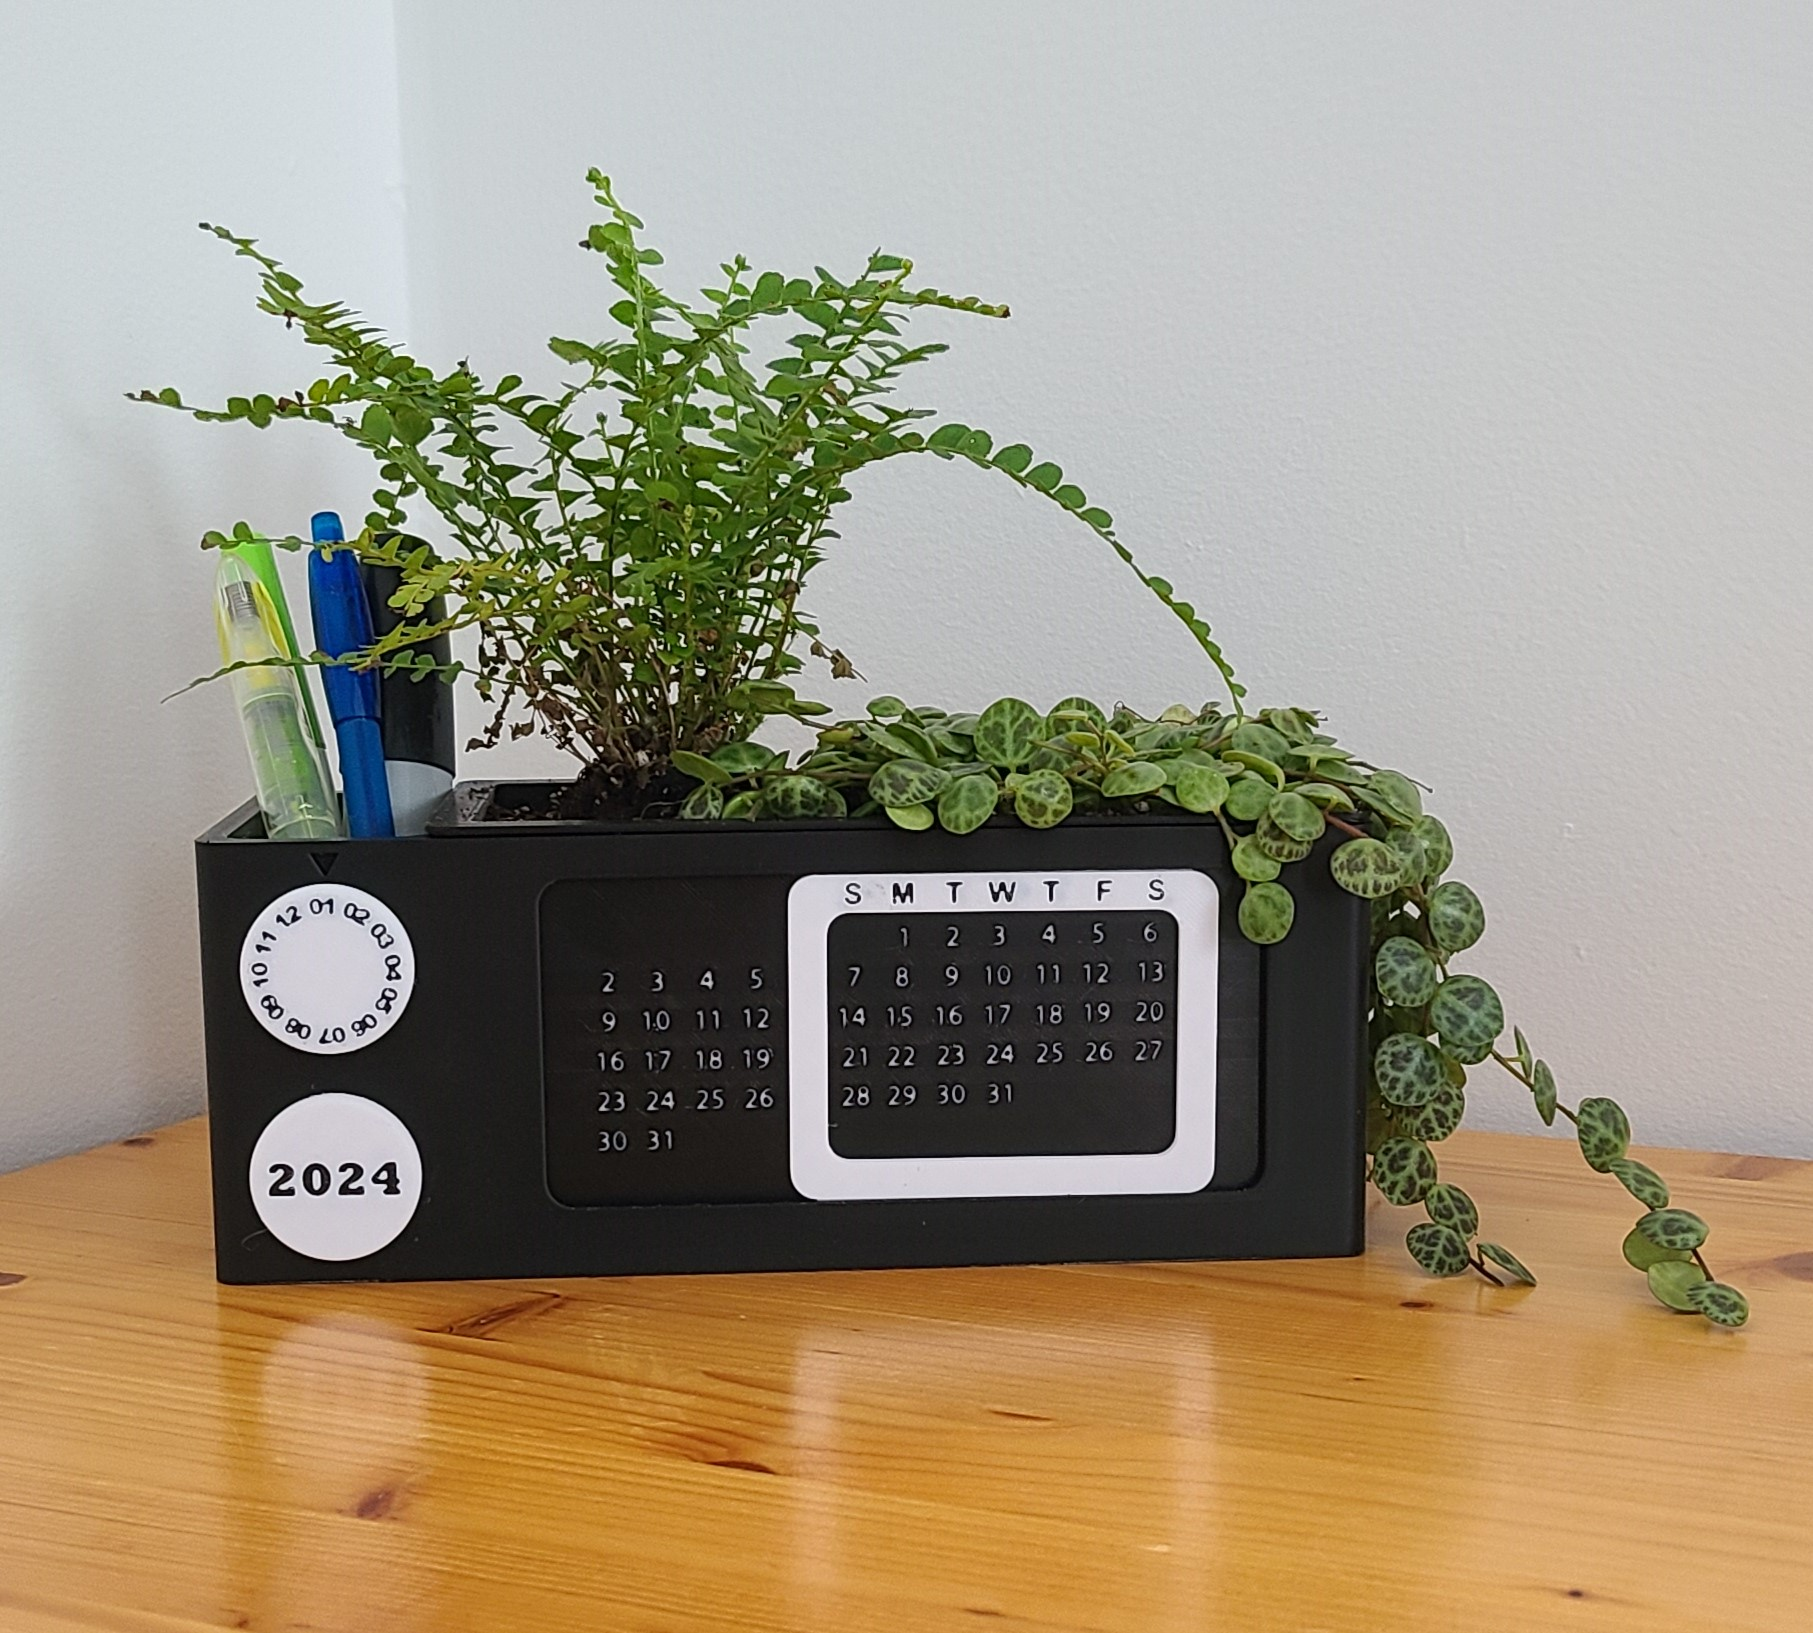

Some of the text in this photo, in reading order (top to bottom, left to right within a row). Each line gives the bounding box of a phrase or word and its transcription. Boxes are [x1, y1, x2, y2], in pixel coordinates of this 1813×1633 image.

[844, 878, 1165, 905] S M T W T F S
[900, 922, 1157, 947] 1 2 3 4 5 6
[251, 898, 402, 1045] 01 02 03 04 05 06 07 08 09 10 11 12
[602, 961, 1167, 993] 2 3 4 5 7 8 9 10 11 12 13
[602, 1001, 1164, 1032] 9 10 11 12 14 15 16 17 18 19 20
[597, 1040, 1162, 1072] 16 17 18 19 21 22 23 24 25 26 27
[598, 1083, 1015, 1112] 23 24 25 26 28 29 30 31
[598, 1130, 673, 1152] 30 31
[268, 1161, 401, 1197] 2024
